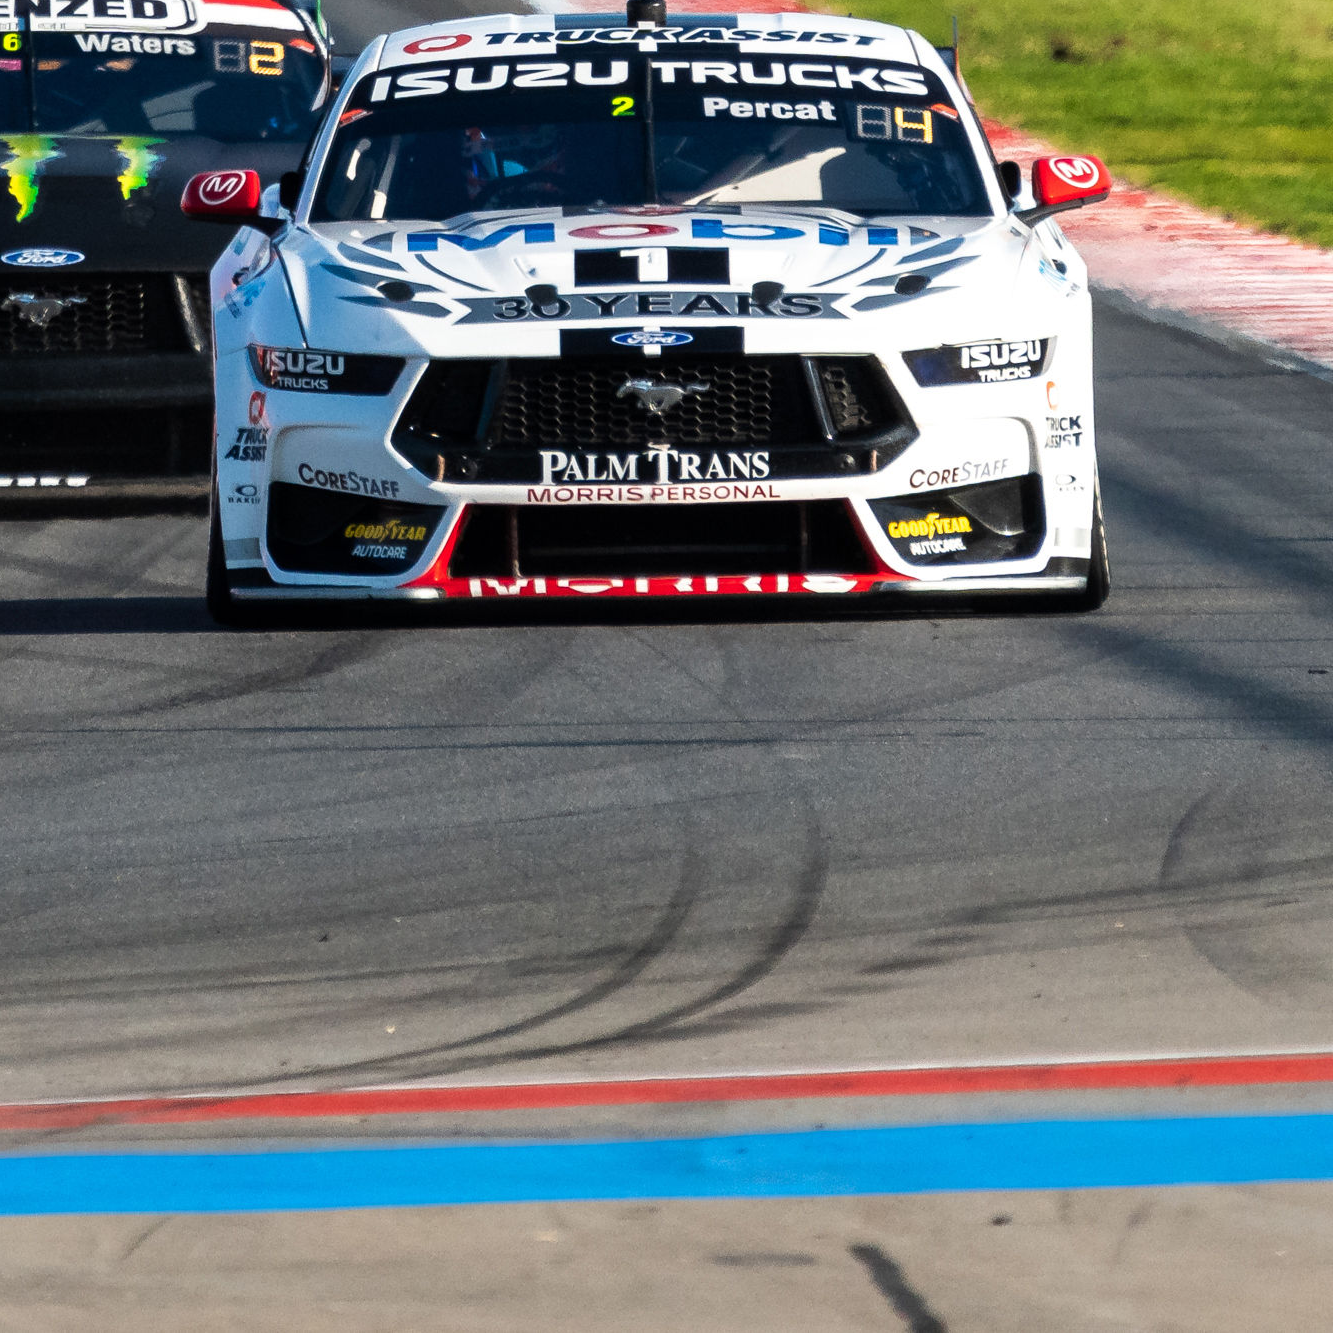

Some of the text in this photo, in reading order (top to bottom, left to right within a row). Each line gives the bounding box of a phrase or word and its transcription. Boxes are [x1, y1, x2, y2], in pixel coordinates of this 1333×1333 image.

[2, 32, 22, 51] 6
[74, 33, 196, 56] Waters
[484, 26, 887, 48] TRUCK ASSIST
[370, 60, 929, 102] ISUZU TRUCKS
[611, 96, 635, 117] 2
[703, 96, 837, 122] Percat
[15, 249, 69, 266] Ford
[582, 292, 826, 318] YEARS
[627, 330, 678, 347] Ford
[265, 351, 346, 376] ISUZU
[960, 338, 1043, 369] ISUZU
[276, 376, 329, 391] TRUCKS
[978, 366, 1032, 383] TRUCKS
[1045, 415, 1083, 431] TRUCK
[235, 427, 271, 446] TRUCK
[539, 447, 771, 486] PALM TRANS
[526, 484, 782, 503] MORRIS PERSONAL
[351, 544, 408, 560] AUTOCARE
[909, 537, 968, 557] AUTOCARE
